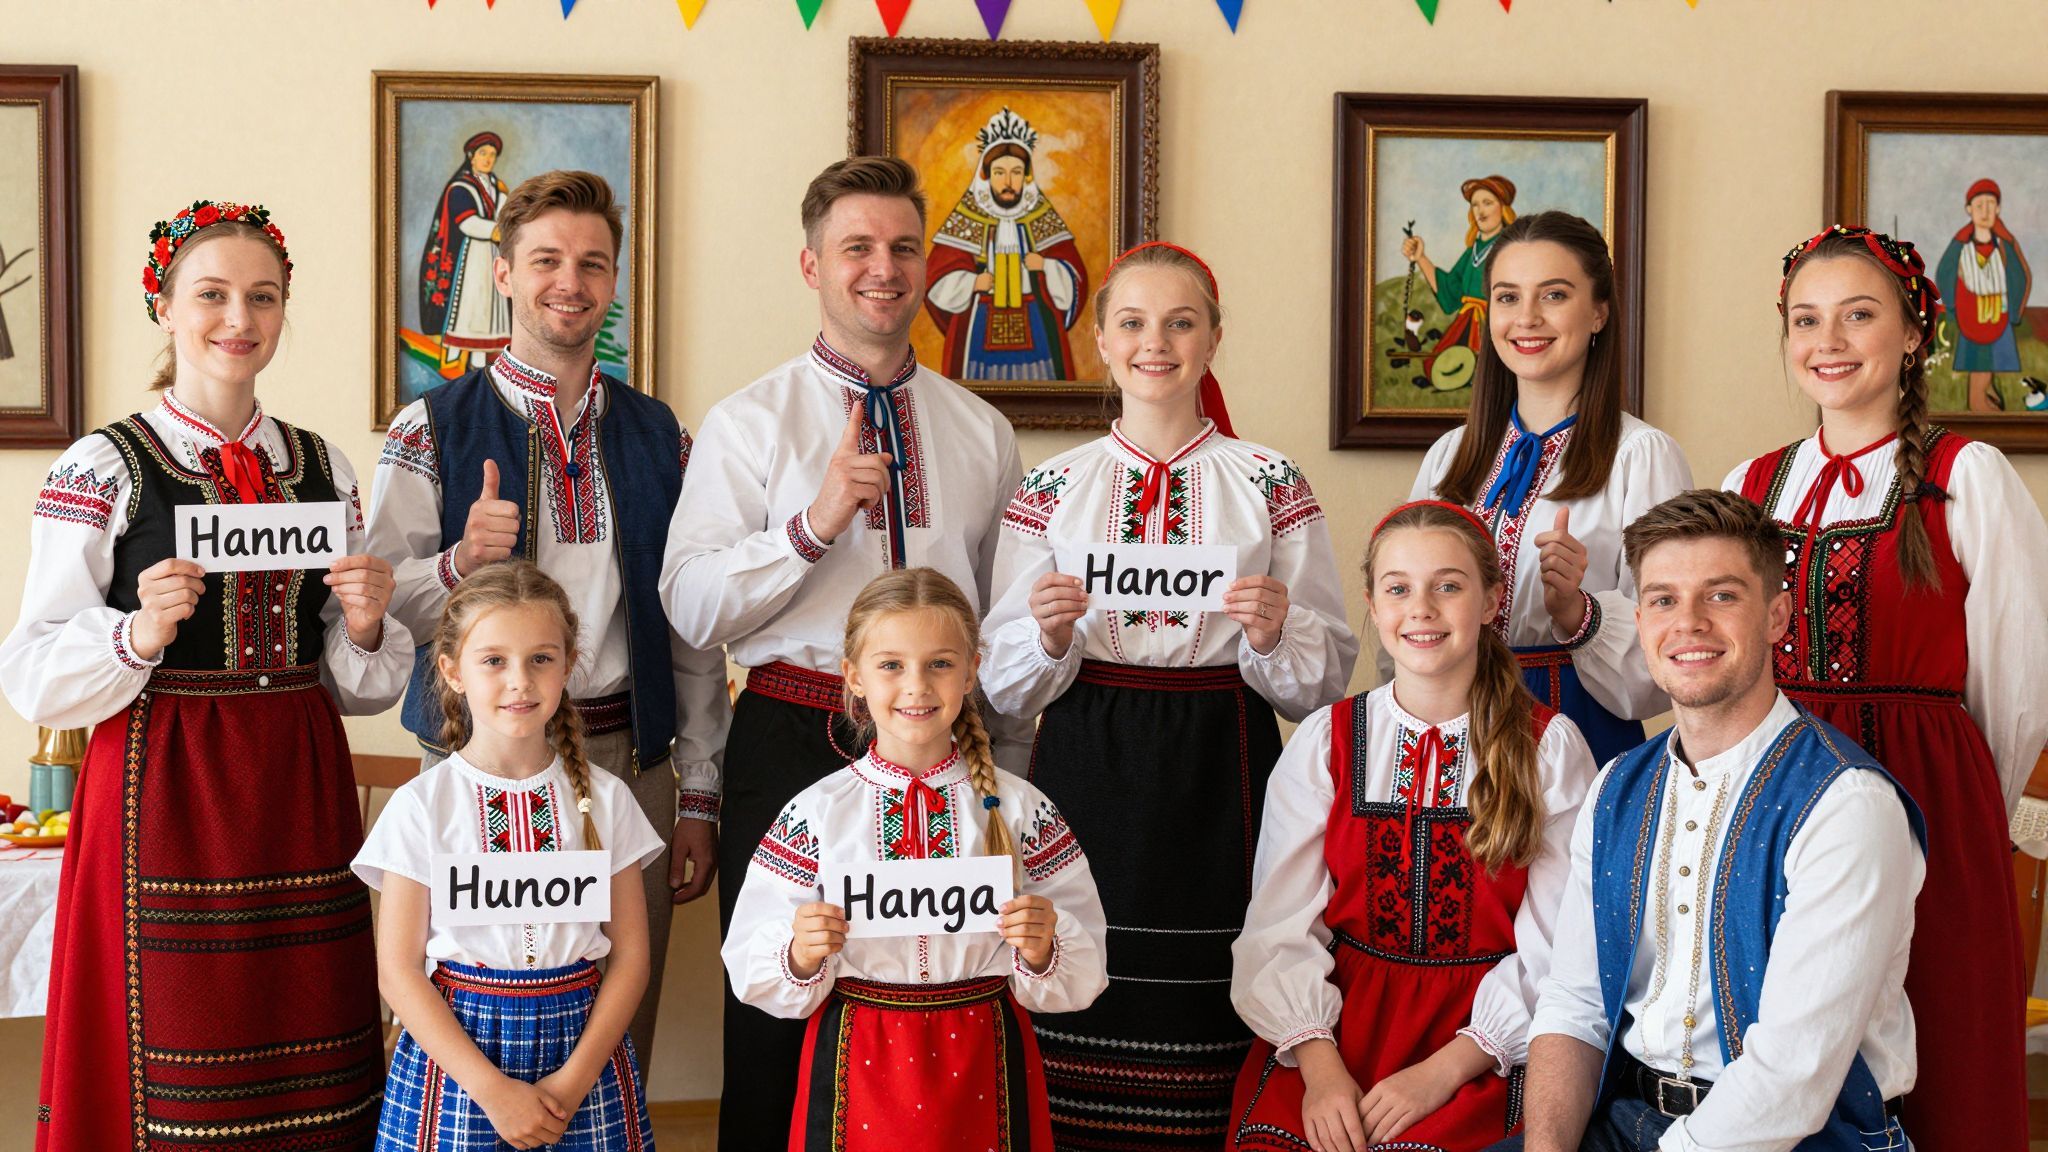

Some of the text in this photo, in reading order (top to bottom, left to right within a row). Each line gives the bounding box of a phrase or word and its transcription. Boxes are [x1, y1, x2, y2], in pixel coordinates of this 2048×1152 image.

[190, 514, 333, 559] Hanna
[1085, 553, 1225, 597] Hanor
[449, 864, 598, 910] Hunor
[843, 873, 1000, 933] Hanga
